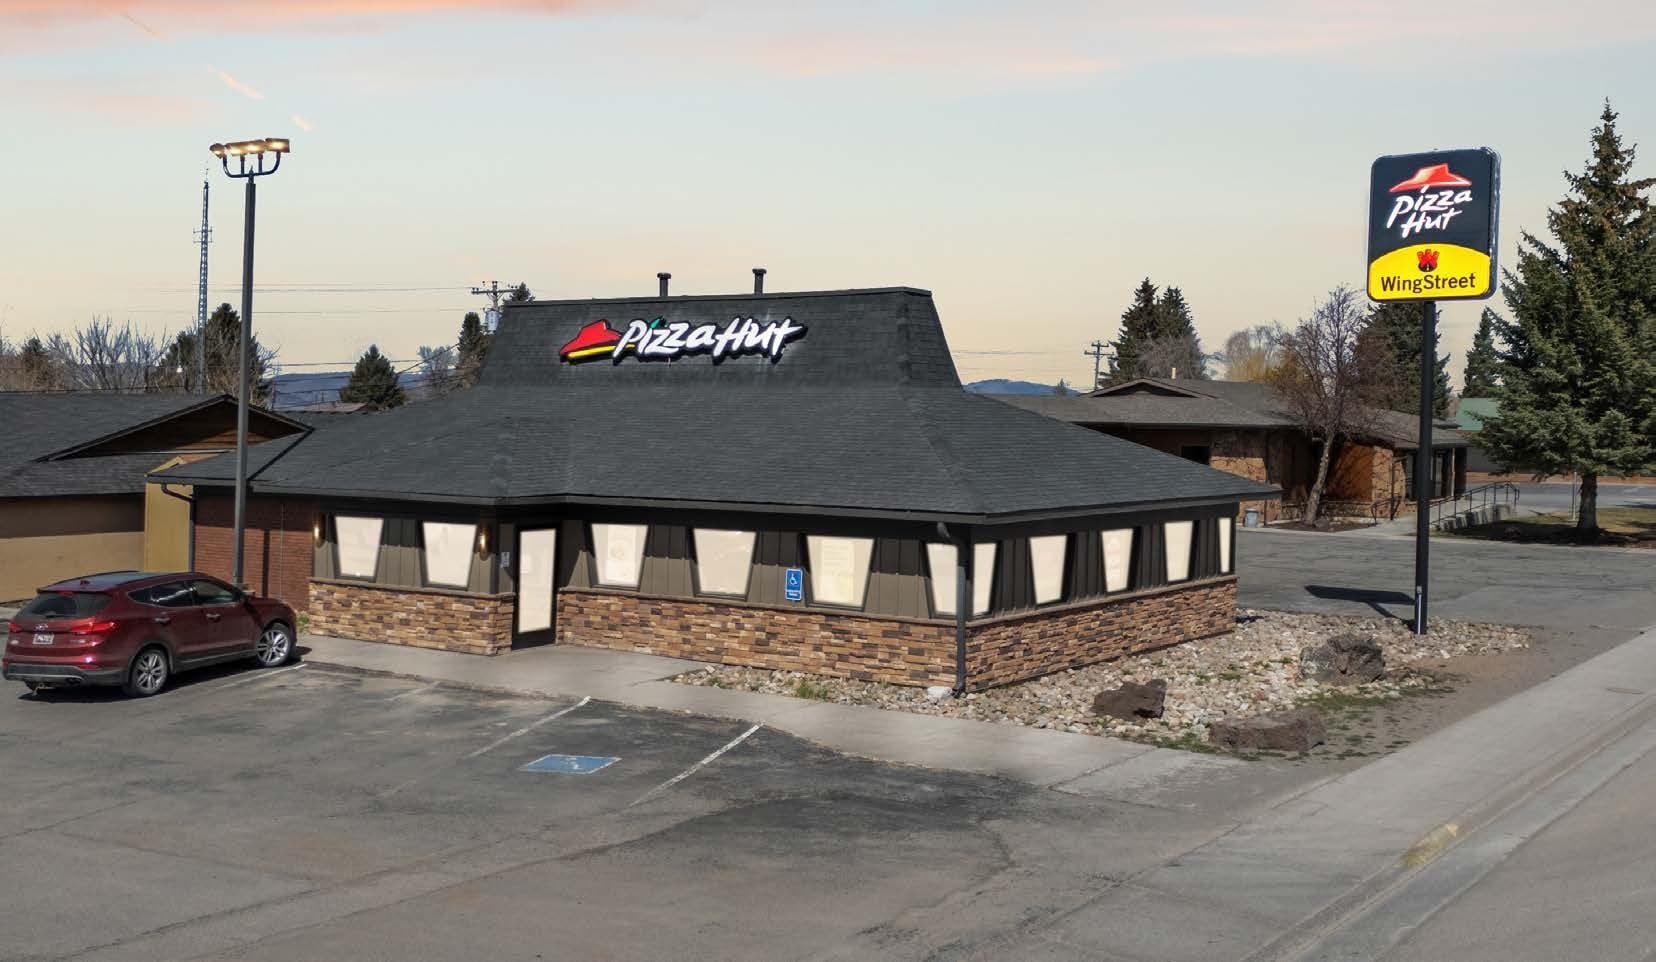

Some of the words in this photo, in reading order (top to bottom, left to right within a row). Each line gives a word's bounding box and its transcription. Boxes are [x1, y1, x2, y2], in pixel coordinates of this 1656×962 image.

[1386, 184, 1473, 229] Pizza
[1400, 207, 1463, 239] Hut
[1380, 273, 1476, 293] WingStreet
[613, 317, 716, 357] Pizza
[712, 317, 803, 357] Hut
